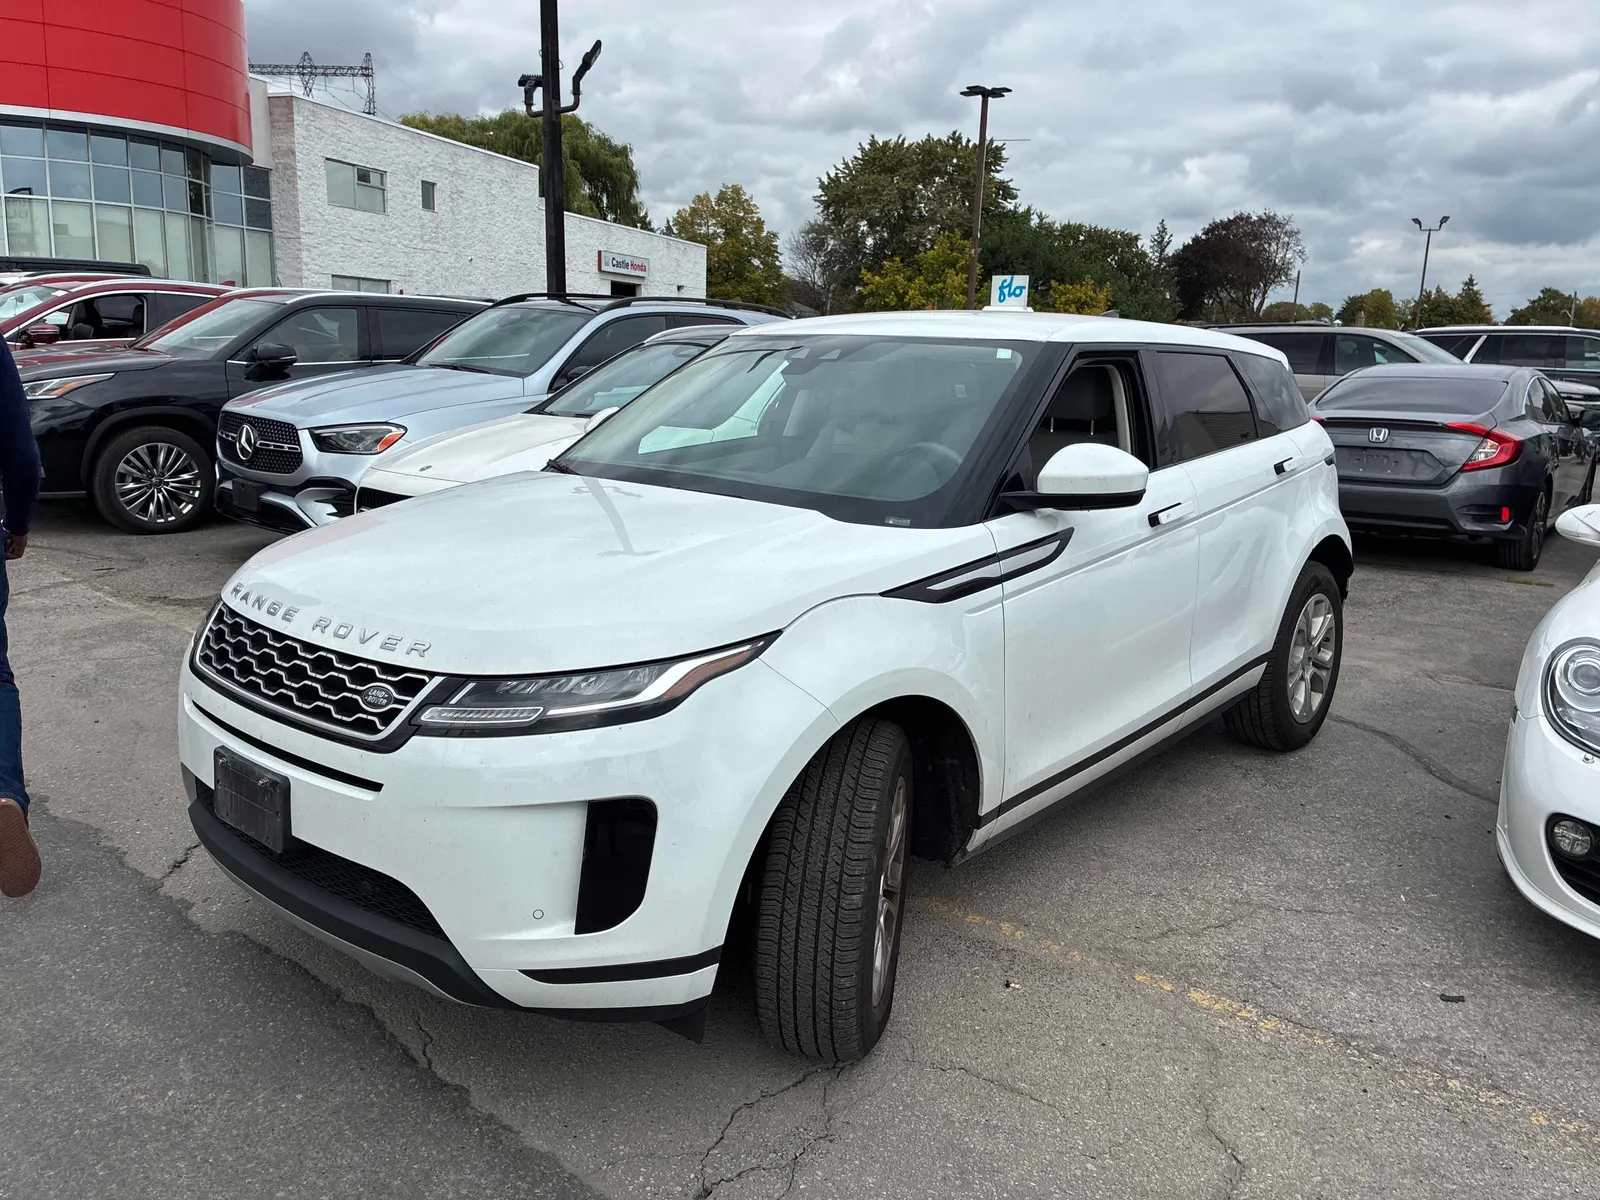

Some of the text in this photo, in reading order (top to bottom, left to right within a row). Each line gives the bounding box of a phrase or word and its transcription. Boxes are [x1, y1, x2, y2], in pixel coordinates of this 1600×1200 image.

[611, 257, 647, 272] Castle Honda
[997, 275, 1026, 303] flo
[230, 582, 432, 657] RANGE ROVER
[366, 695, 388, 706] ROVER
[368, 689, 385, 698] LAND
